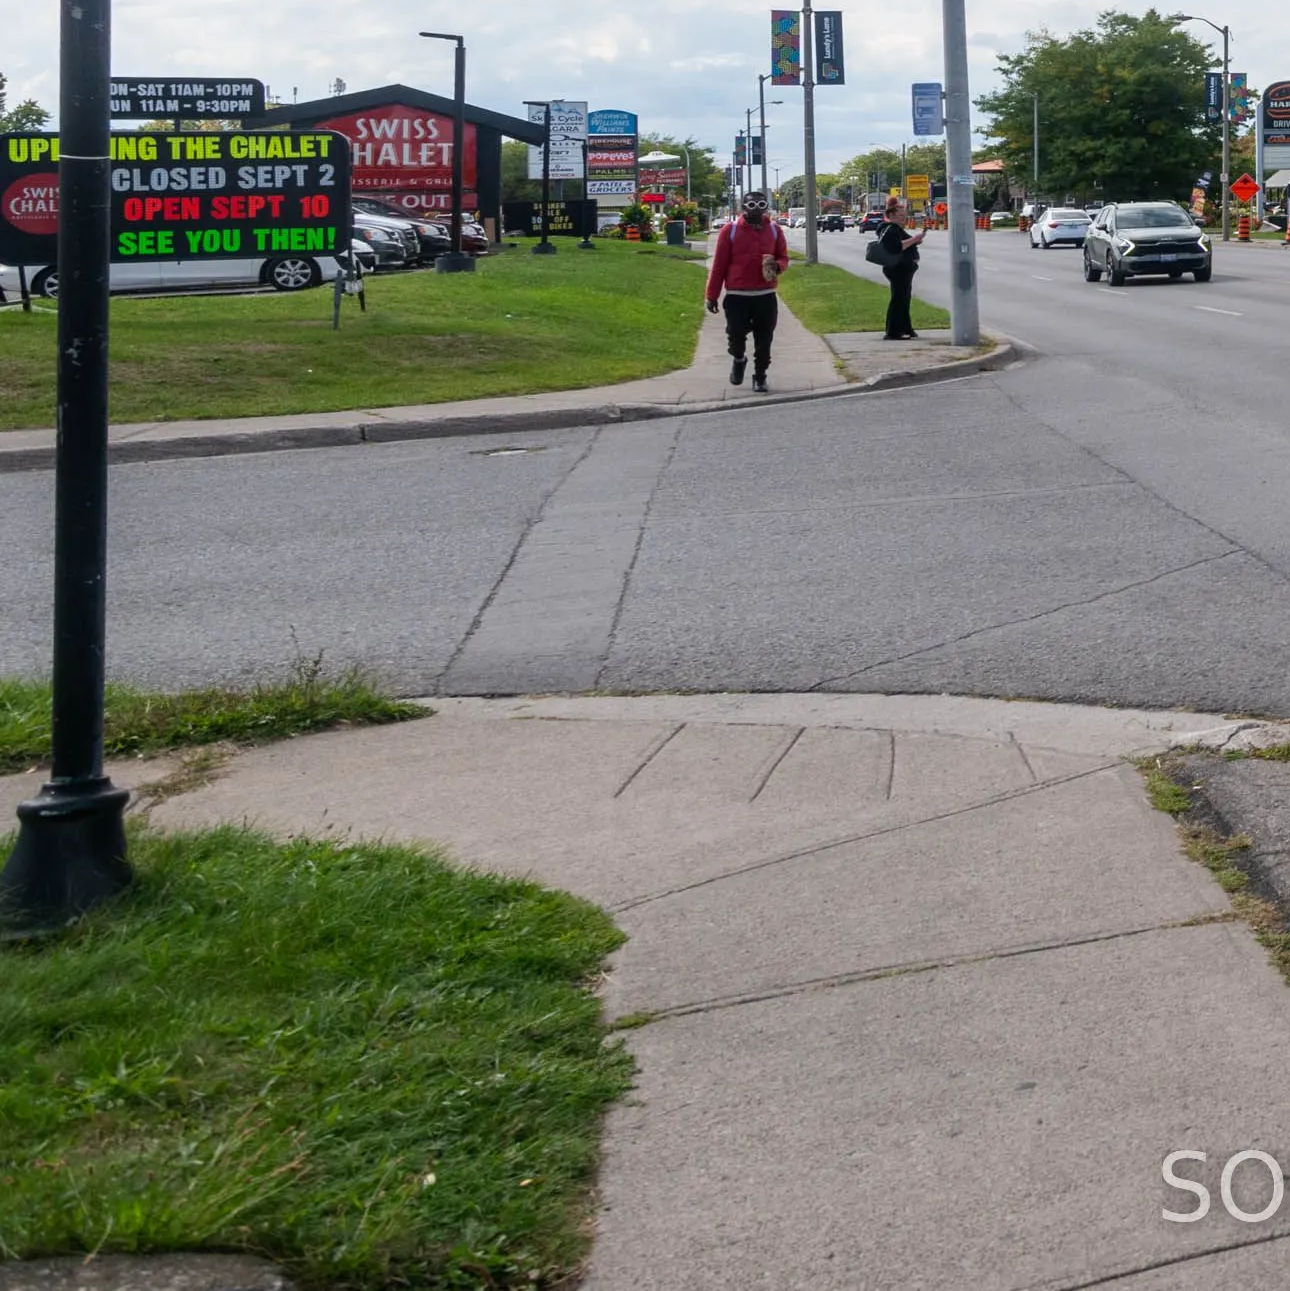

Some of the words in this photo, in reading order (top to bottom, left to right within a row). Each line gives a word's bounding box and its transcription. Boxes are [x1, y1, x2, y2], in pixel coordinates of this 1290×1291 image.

[110, 84, 165, 97] ON-SAT
[169, 83, 254, 97] 11AM-10PM
[110, 100, 131, 112] UN
[140, 100, 179, 112] 11AM
[196, 99, 251, 112] 9:30PM
[355, 118, 439, 140] SWISS
[560, 115, 584, 123] Cycle
[166, 137, 222, 159] THE
[230, 135, 333, 159] CHALET
[352, 142, 454, 166] HALET
[111, 166, 227, 192] CLOSED
[237, 164, 309, 190] SEPT
[319, 164, 336, 187] 2
[9, 197, 60, 216] CHAL
[123, 196, 201, 221] OPEN
[210, 195, 285, 219] SEPT
[300, 194, 330, 219] 10
[401, 194, 450, 208] OUT
[118, 230, 174, 255] SEE
[185, 228, 241, 254] YOU
[253, 226, 337, 251] THEN!
